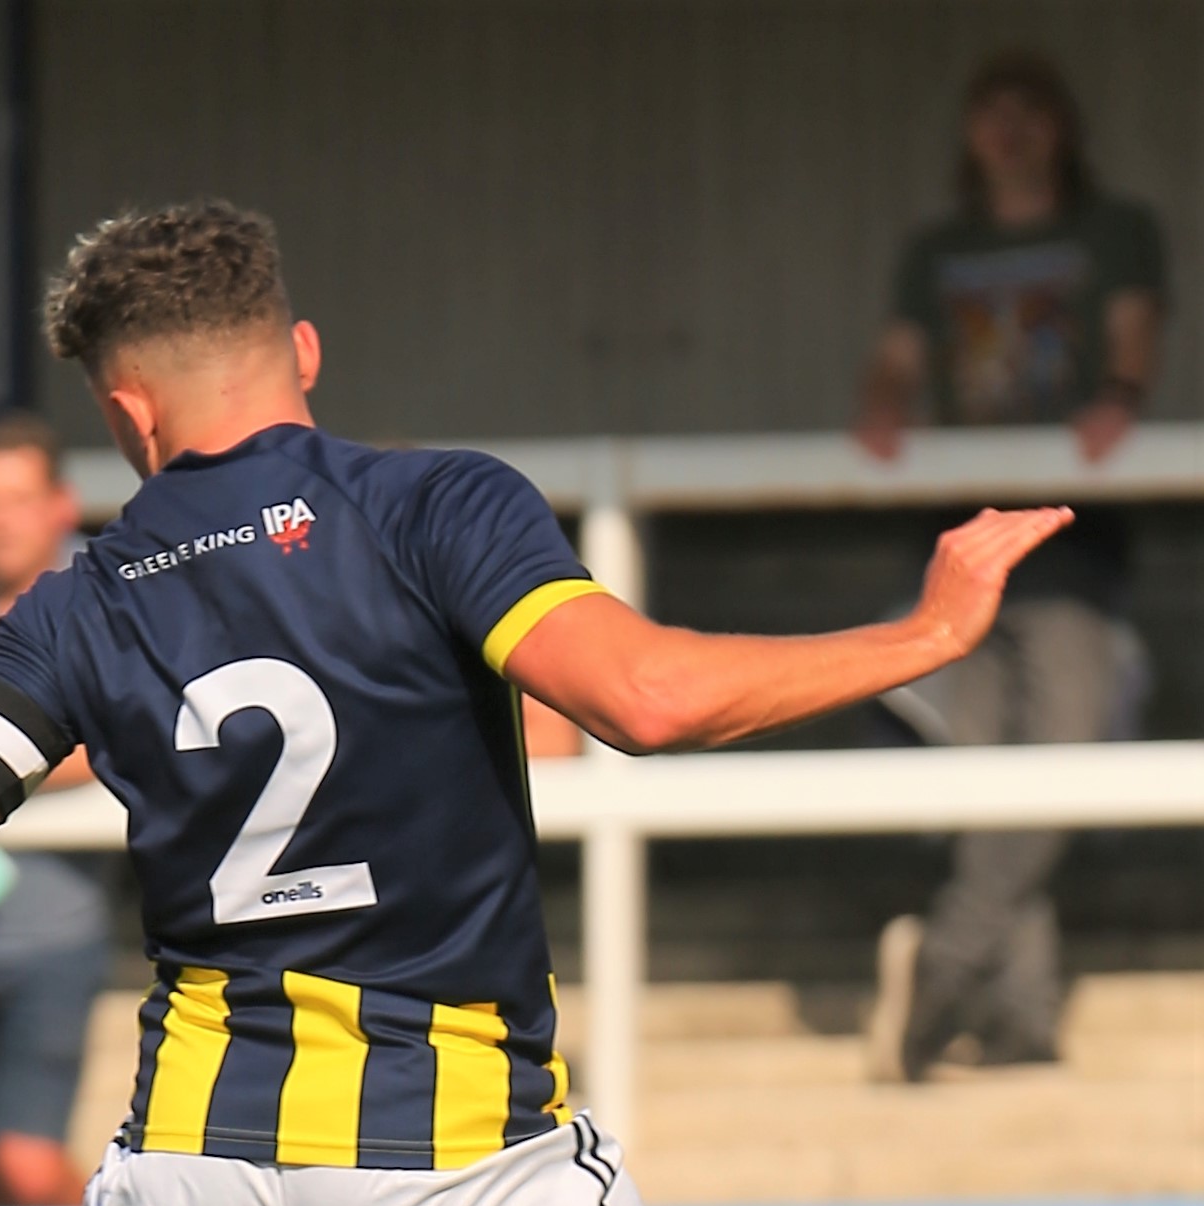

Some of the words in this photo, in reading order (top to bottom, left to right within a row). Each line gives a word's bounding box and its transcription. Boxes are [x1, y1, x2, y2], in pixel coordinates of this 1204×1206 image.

[194, 525, 256, 556] KING
[261, 497, 317, 537] IPA
[174, 656, 380, 927] 2
